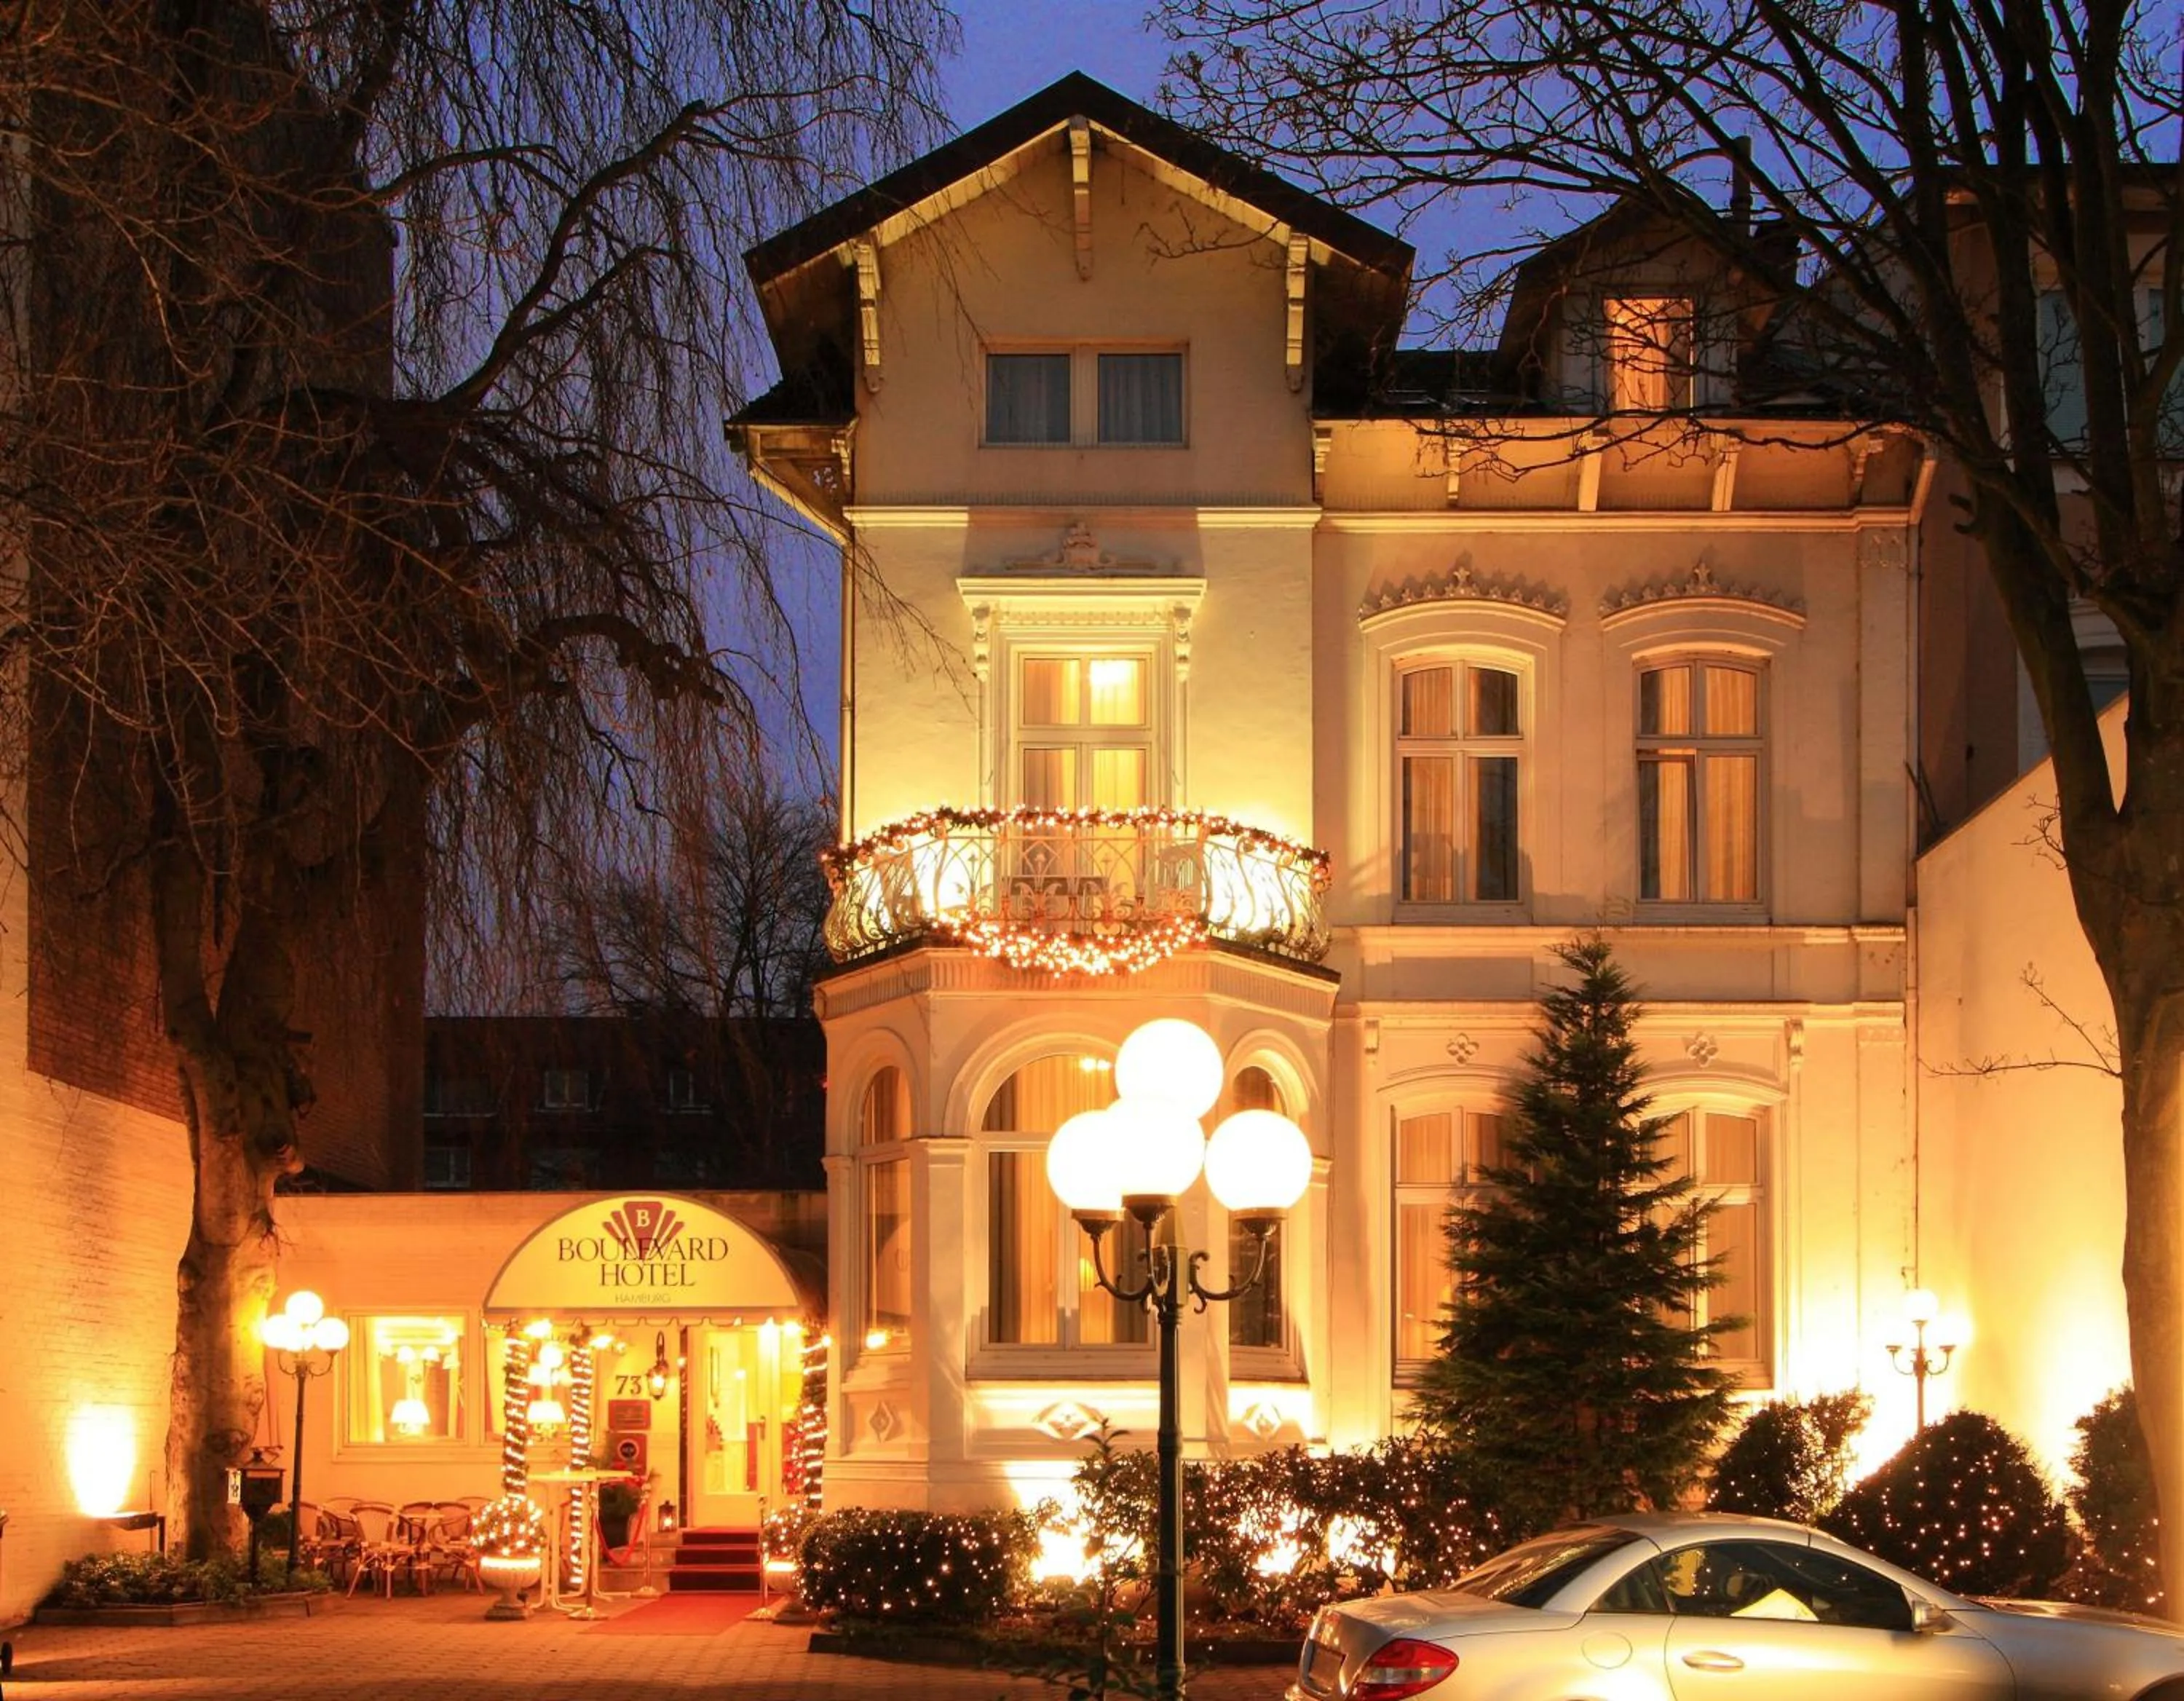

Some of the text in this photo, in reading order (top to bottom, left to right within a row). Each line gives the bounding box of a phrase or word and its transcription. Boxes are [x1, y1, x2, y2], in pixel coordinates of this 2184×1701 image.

[636, 1209, 651, 1227] B
[558, 1237, 729, 1262] BOULEVARD
[599, 1263, 697, 1287] HOTEL
[614, 1292, 672, 1304] HAMBURG
[615, 1376, 642, 1395] 73
